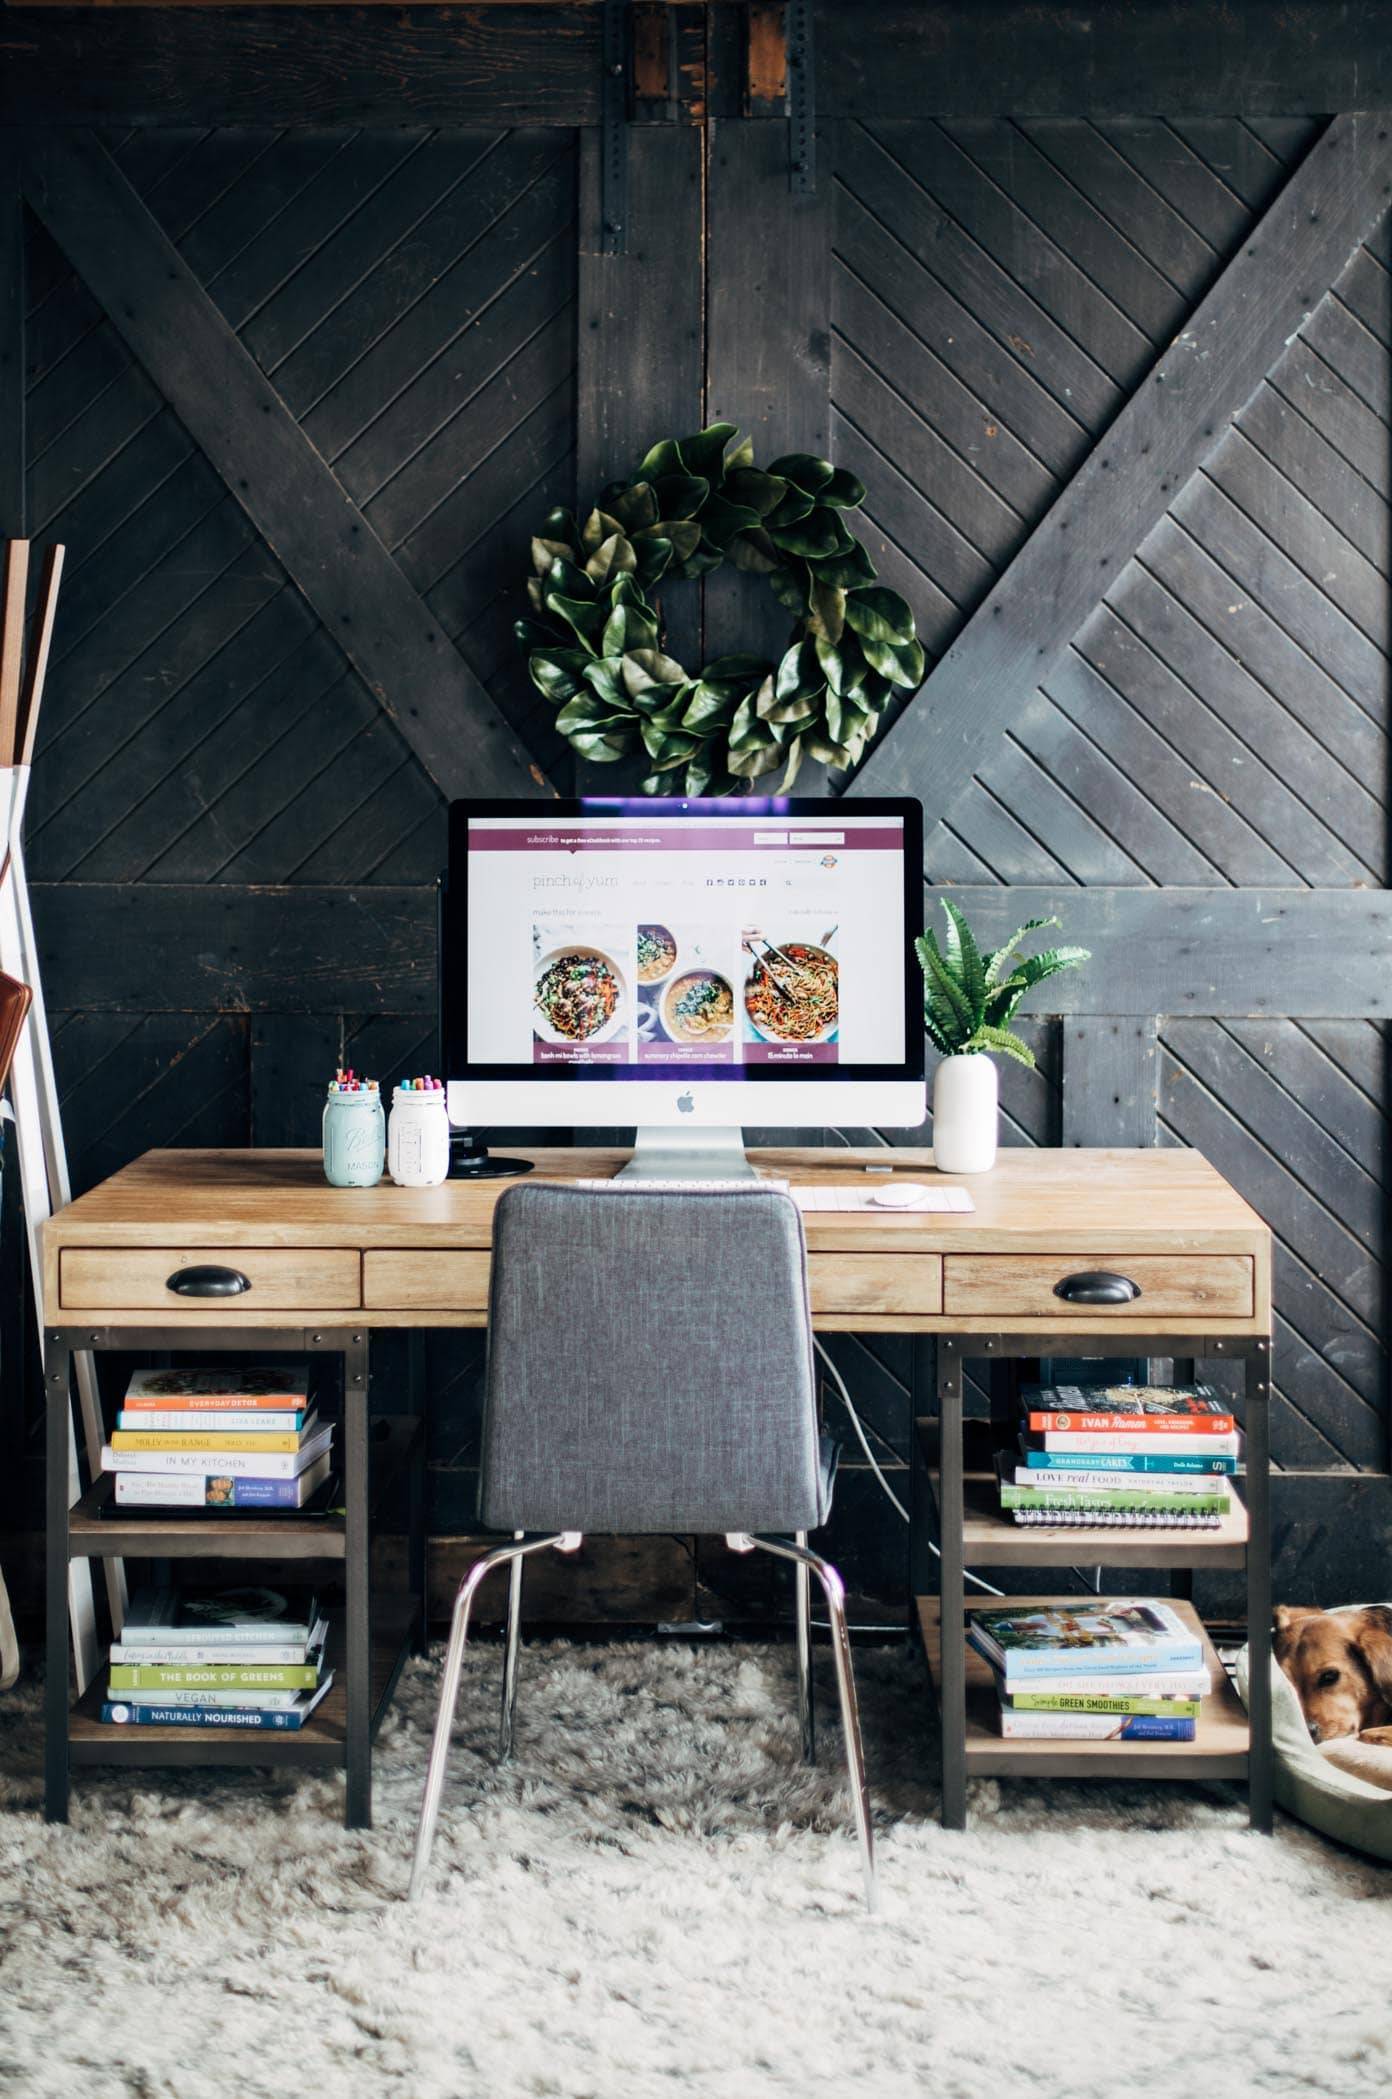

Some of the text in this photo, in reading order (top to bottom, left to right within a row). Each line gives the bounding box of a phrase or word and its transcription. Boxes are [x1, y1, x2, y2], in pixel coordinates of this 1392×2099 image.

[527, 835, 559, 844] subscribe
[532, 873, 571, 889] pinch
[585, 874, 618, 890] yum
[346, 1161, 379, 1172] MASON
[189, 1400, 258, 1408] EVERYDAY DETOX
[1082, 1416, 1147, 1430] IVAN Ramen
[181, 1439, 211, 1447] RANGE
[166, 1457, 246, 1469] IN MY KITCHEN
[1101, 1457, 1127, 1468] CAKES
[1036, 1472, 1121, 1486] LOVE real FOOD
[1045, 1494, 1075, 1506] Fresh
[234, 1632, 276, 1641] KITCHEN
[160, 1672, 284, 1682] THE BOOK OF GREENS
[1136, 1680, 1166, 1690] EVERY
[175, 1692, 217, 1704] VEGAN
[1030, 1694, 1058, 1708] Simple
[1060, 1697, 1084, 1709] GREEN
[1087, 1698, 1130, 1711] SMOOTHIES
[151, 1711, 202, 1722] NATURALLY
[204, 1712, 262, 1724] NOURISHED
